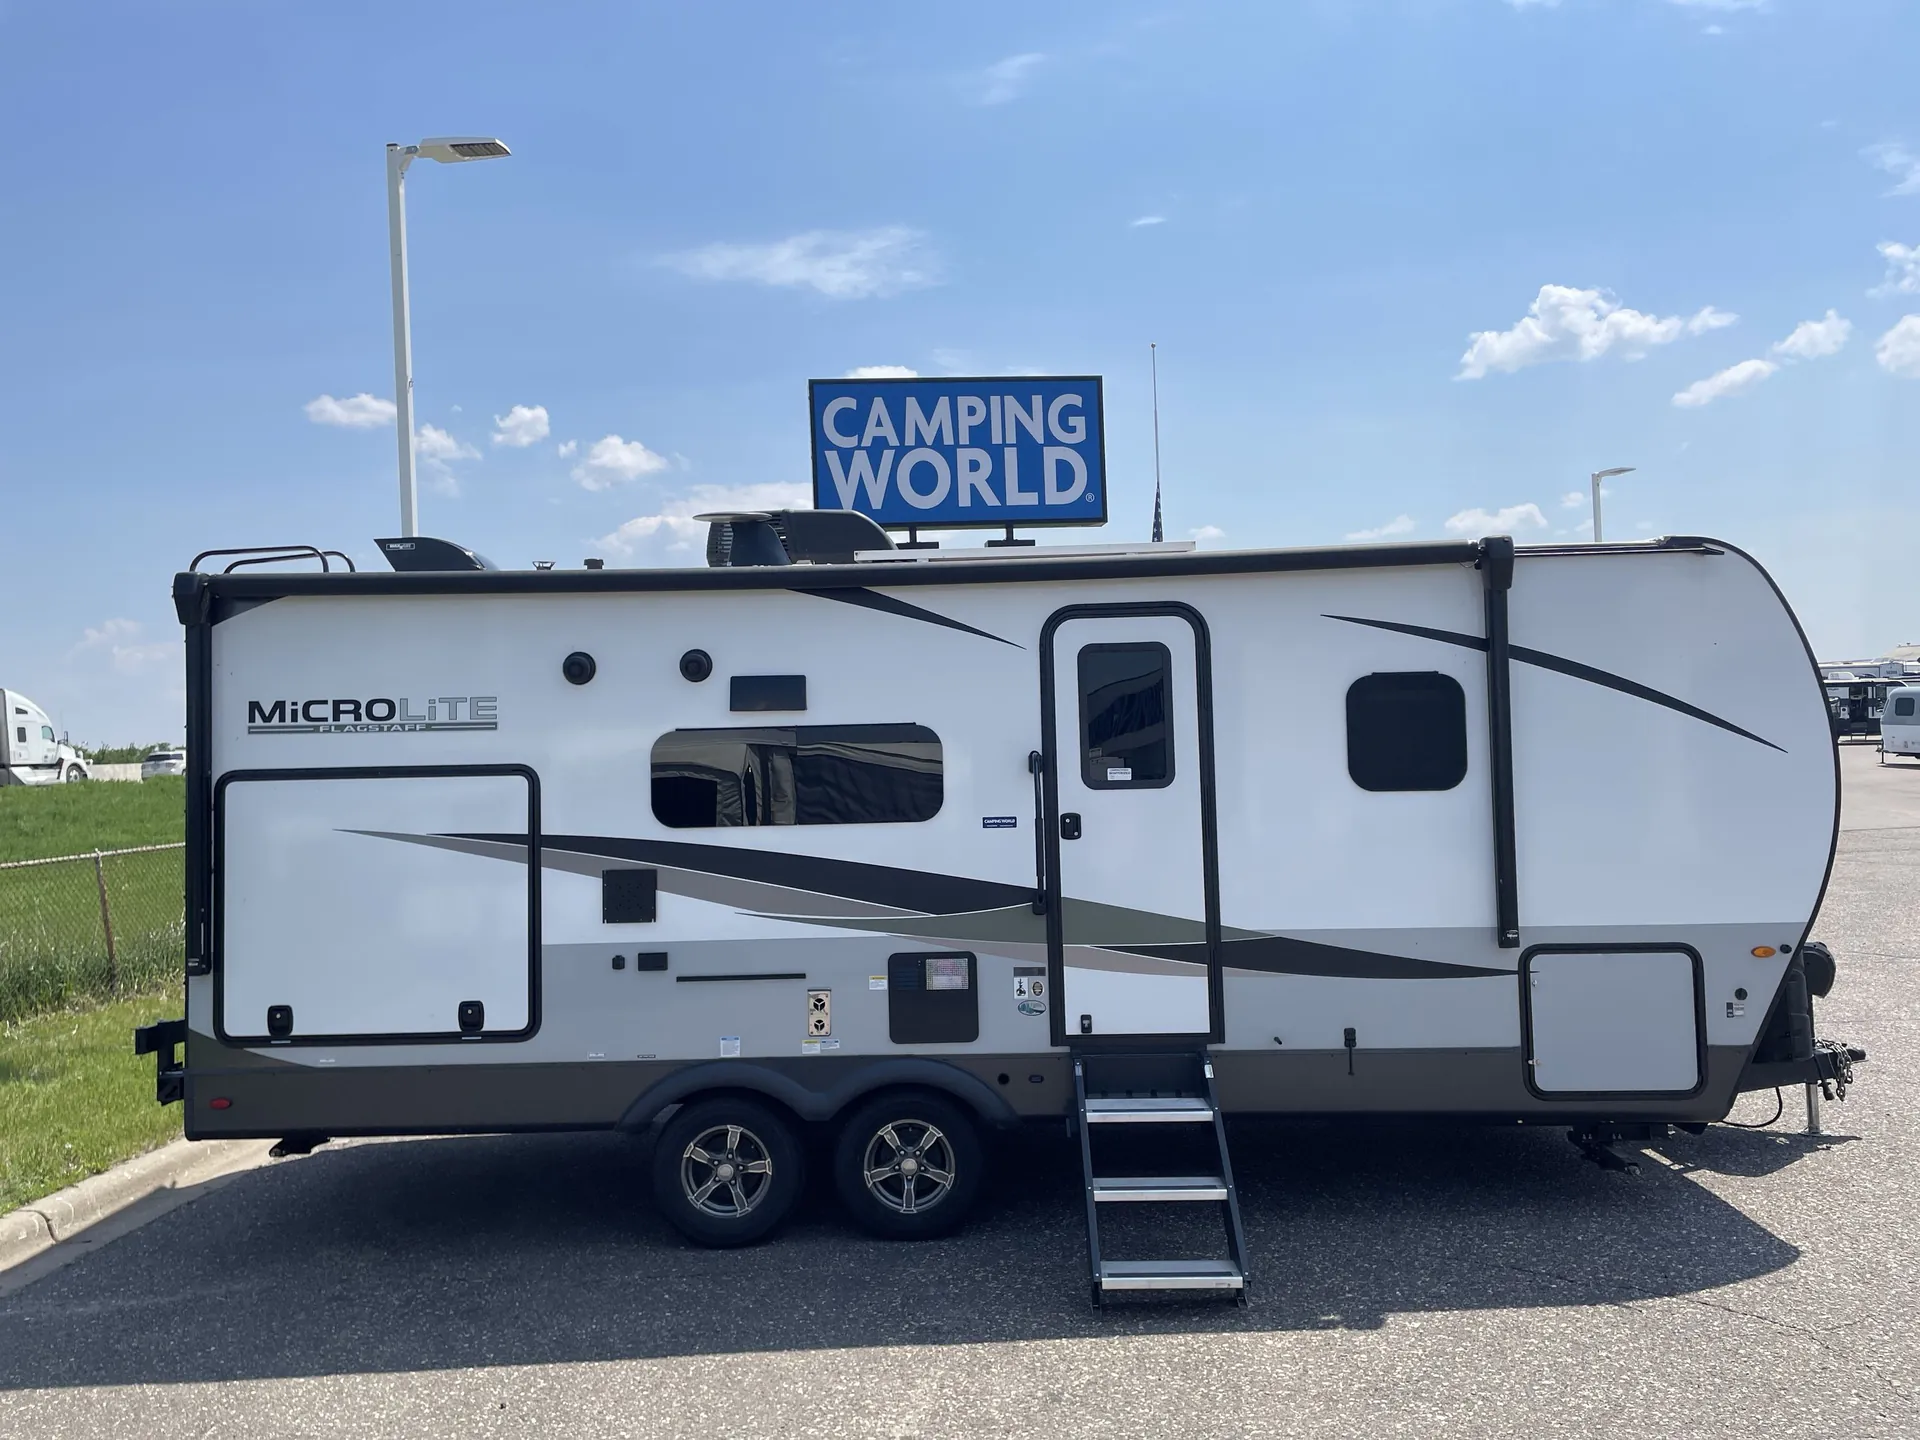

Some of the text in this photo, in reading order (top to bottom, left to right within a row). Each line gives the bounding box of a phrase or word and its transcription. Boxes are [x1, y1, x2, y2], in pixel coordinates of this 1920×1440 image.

[822, 394, 1087, 448] CAMPING
[824, 446, 1088, 510] WORLD
[318, 723, 427, 733] FLAGSTAFF
